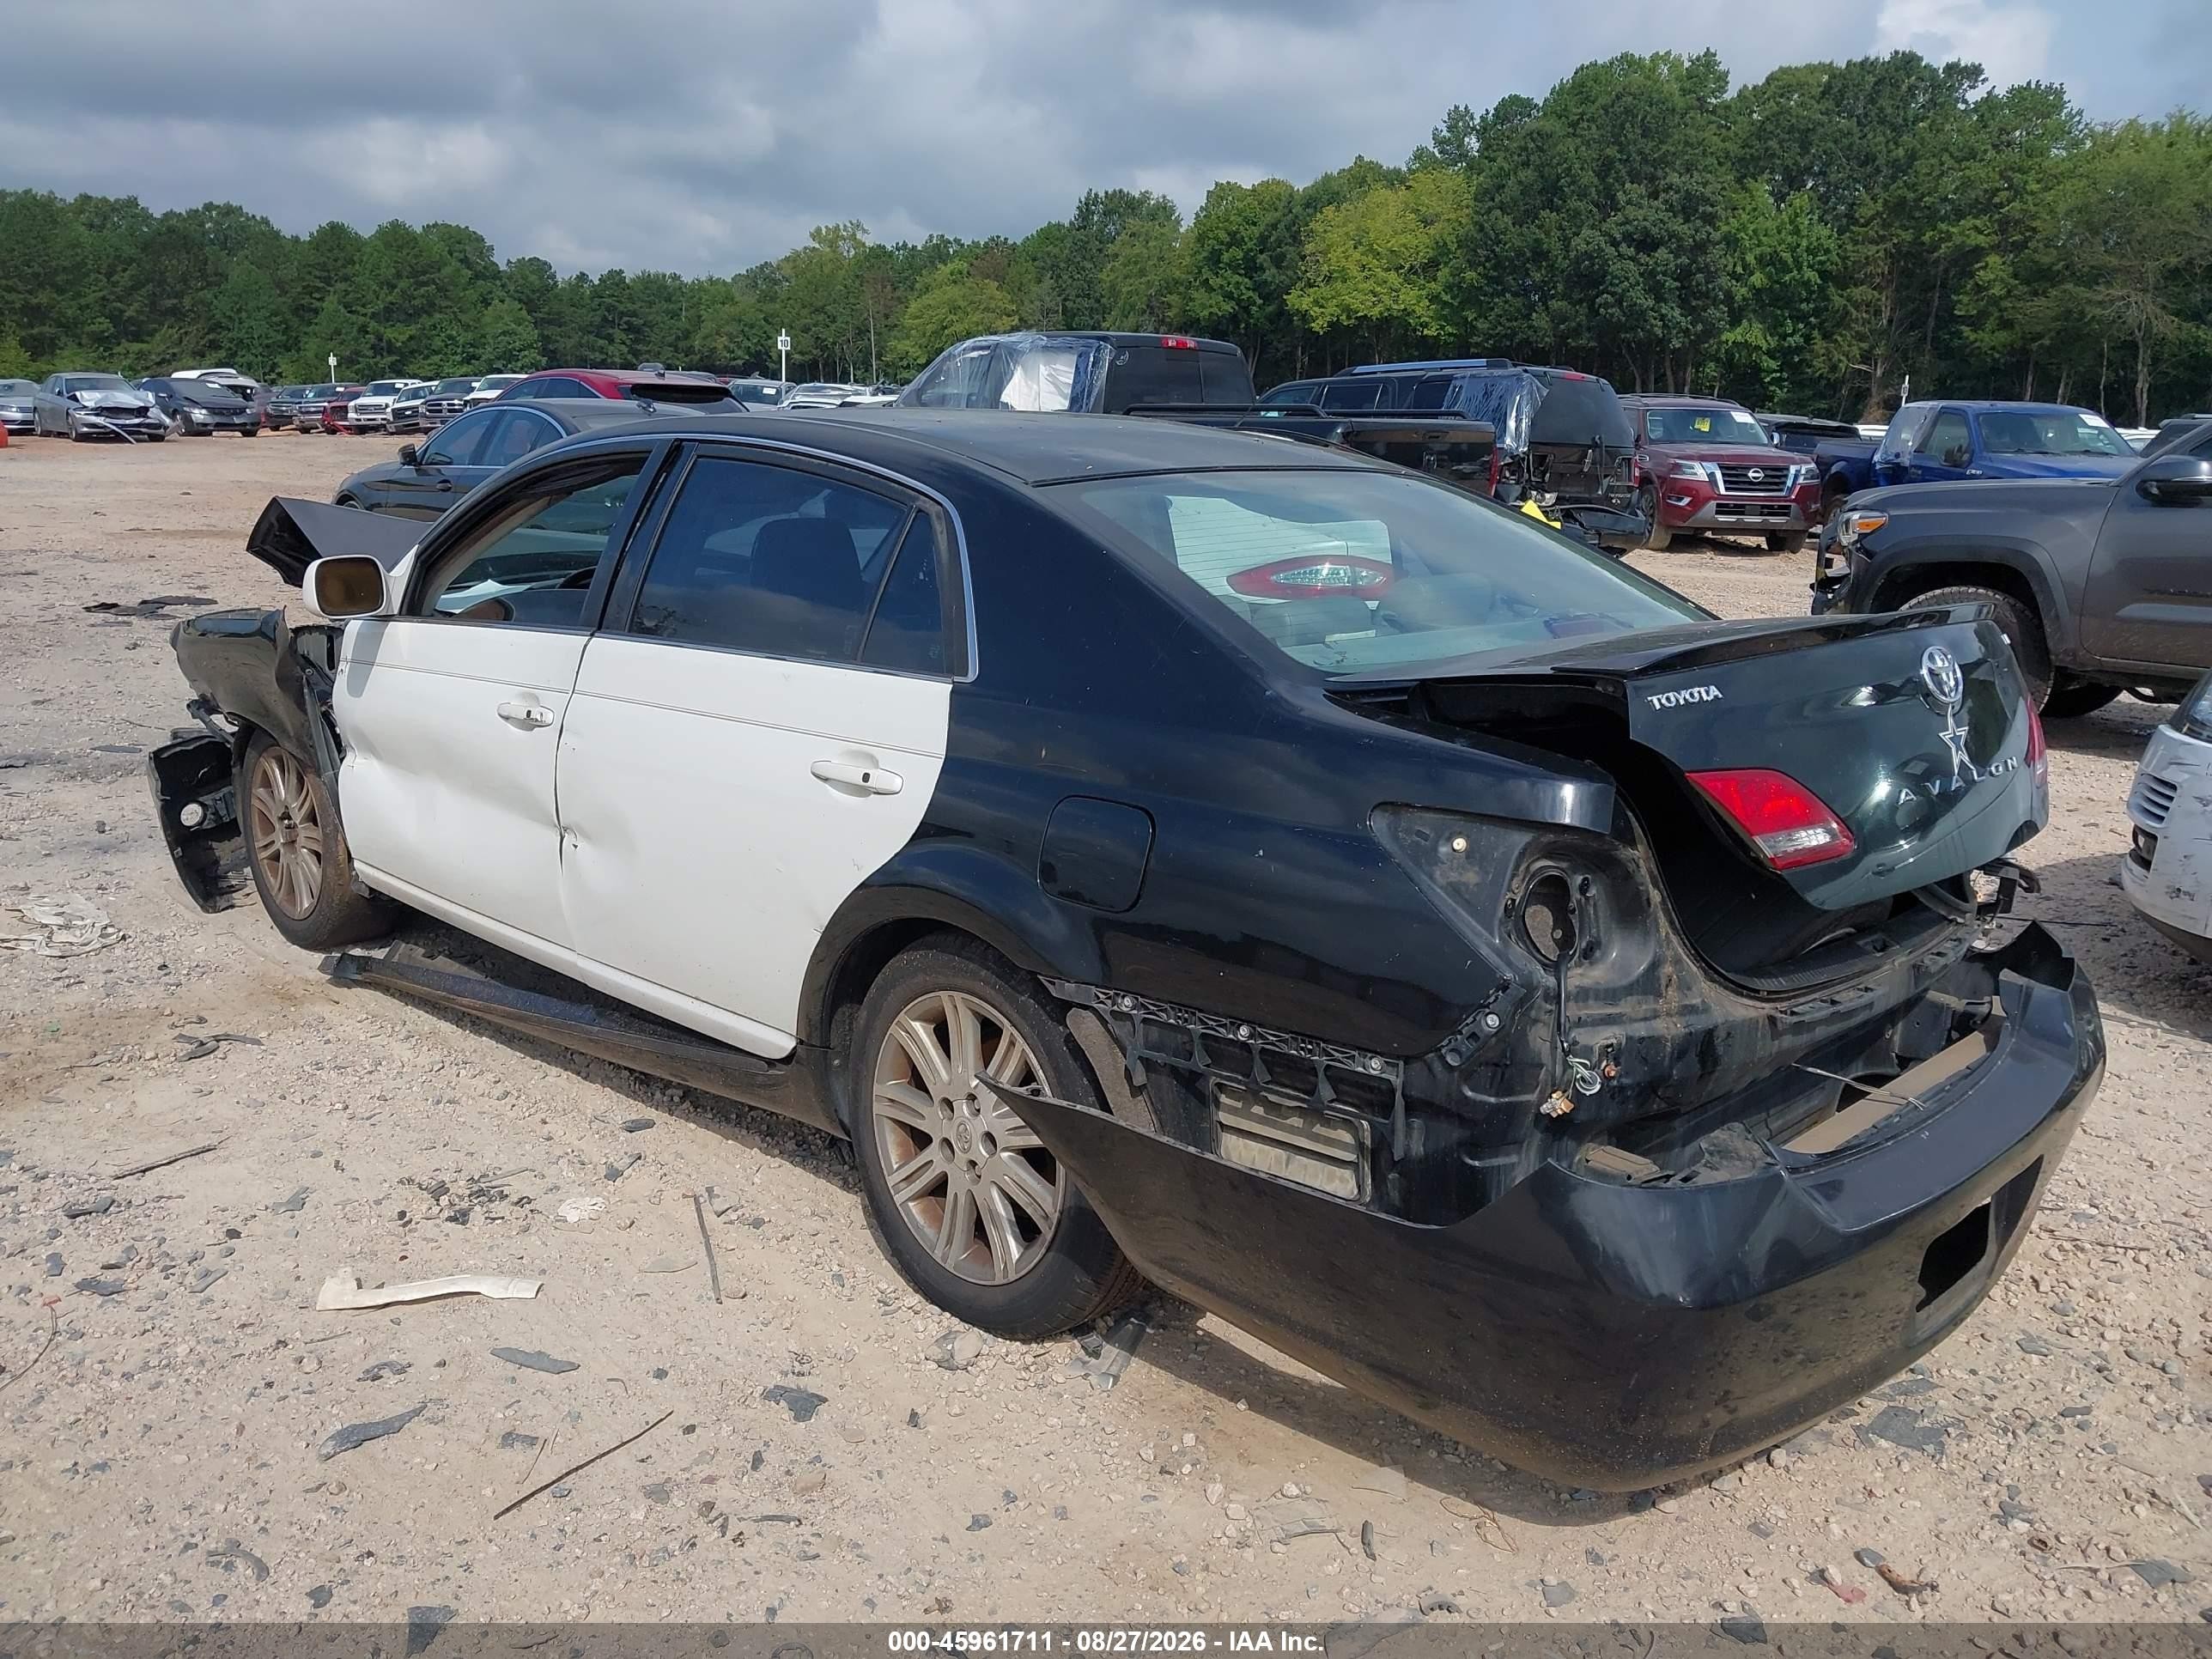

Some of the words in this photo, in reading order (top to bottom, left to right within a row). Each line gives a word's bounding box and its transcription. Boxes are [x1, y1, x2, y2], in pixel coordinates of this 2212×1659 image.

[780, 338, 789, 349] 10
[1645, 684, 1724, 711] TOYOTA
[1896, 755, 2020, 806] AVALON
